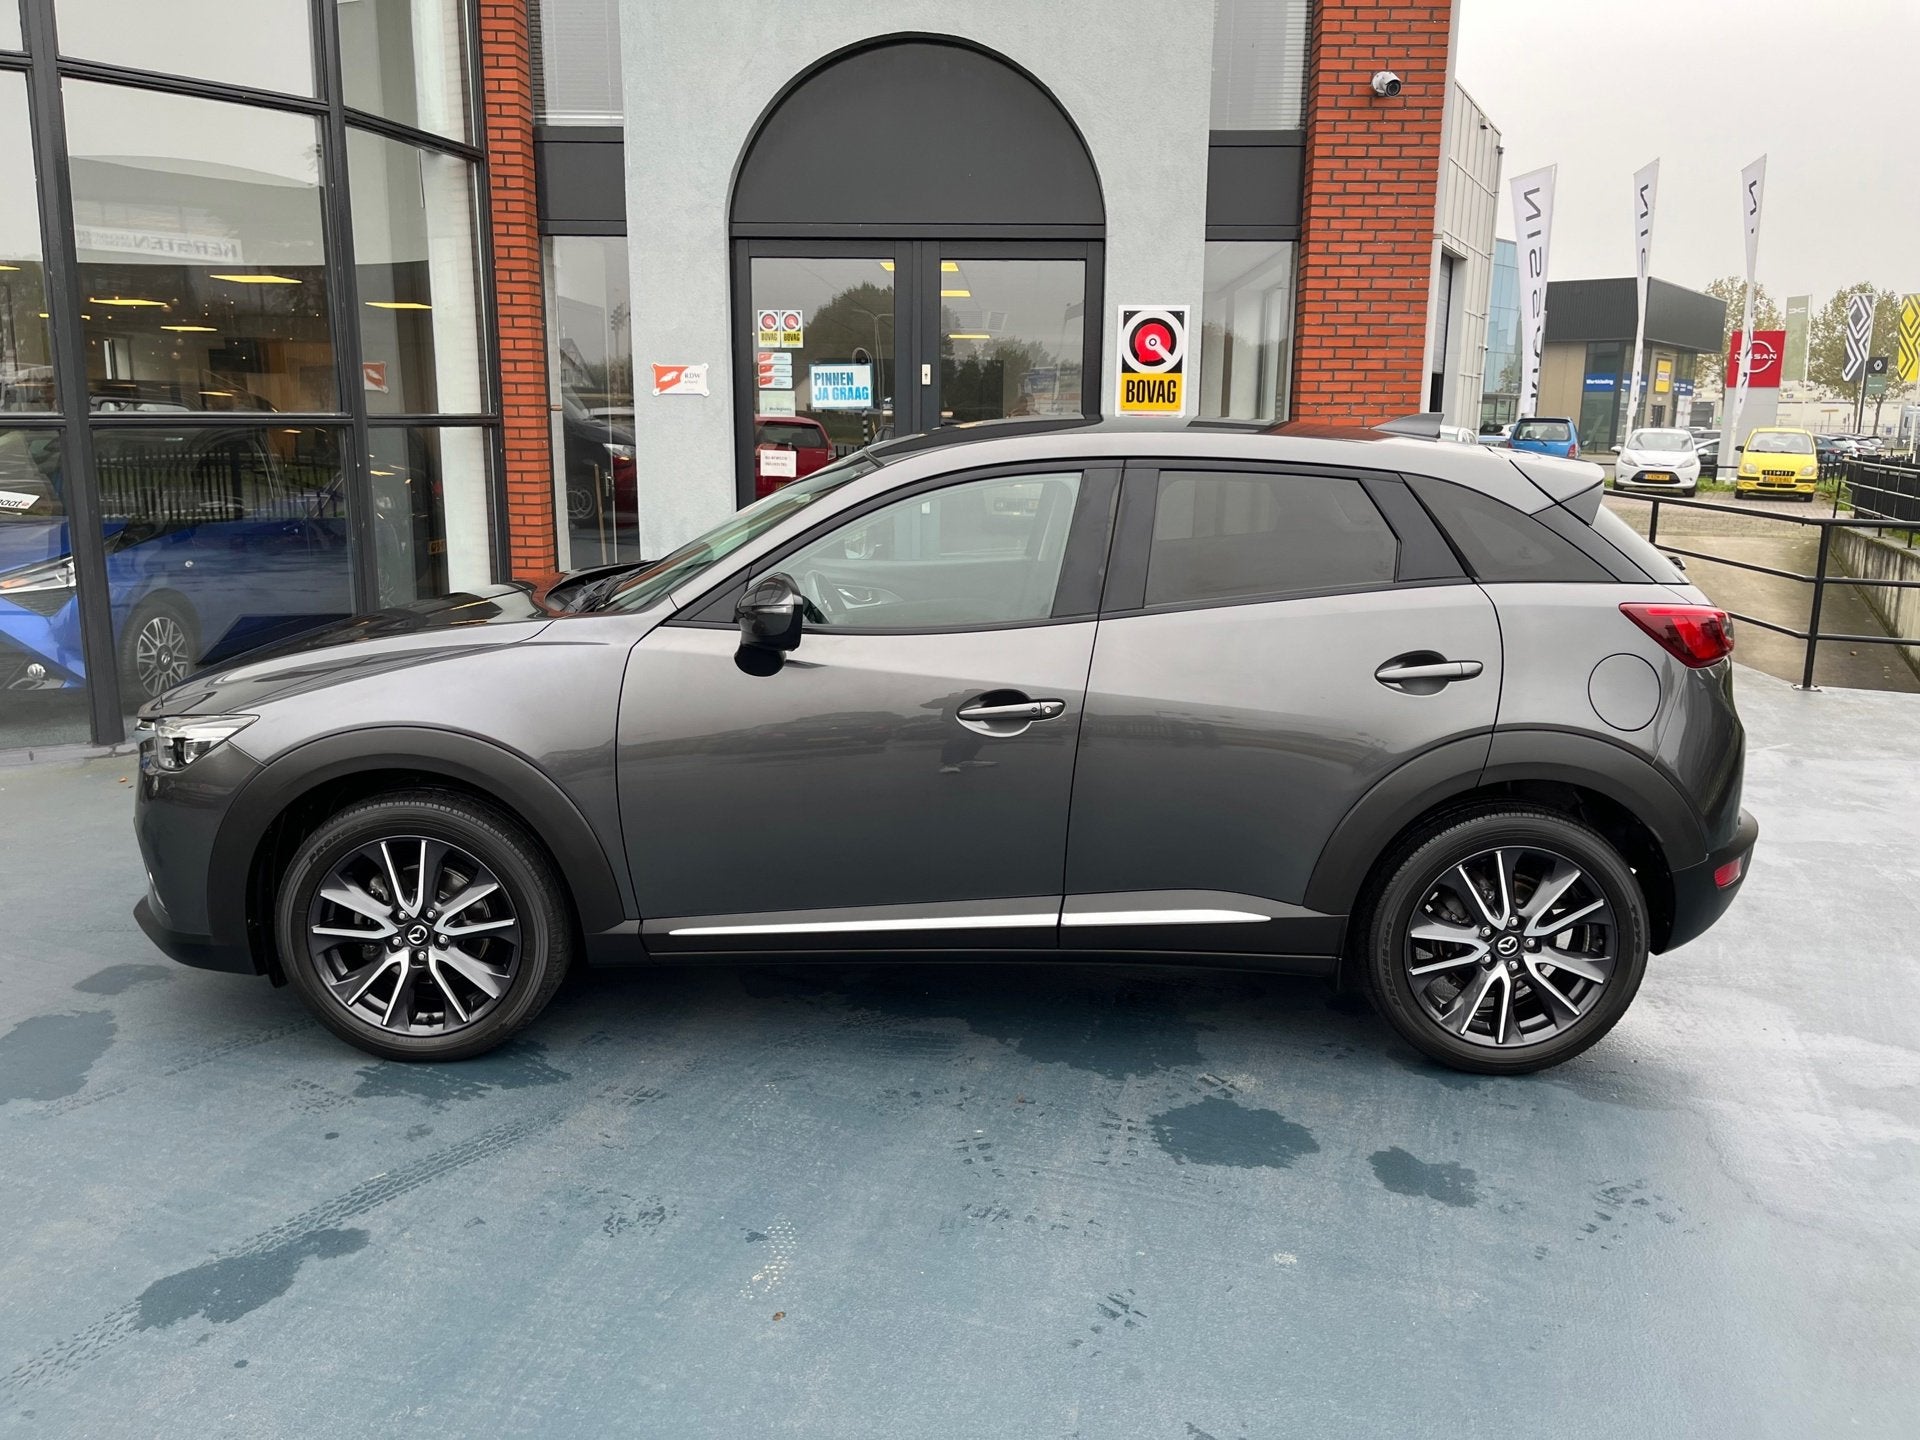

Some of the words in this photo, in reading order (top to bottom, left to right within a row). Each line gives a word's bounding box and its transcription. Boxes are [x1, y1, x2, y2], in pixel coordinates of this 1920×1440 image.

[814, 371, 854, 386] PINNEN
[815, 386, 829, 401] JA
[832, 386, 869, 401] GRAAG
[1125, 379, 1177, 403] BOVAG
